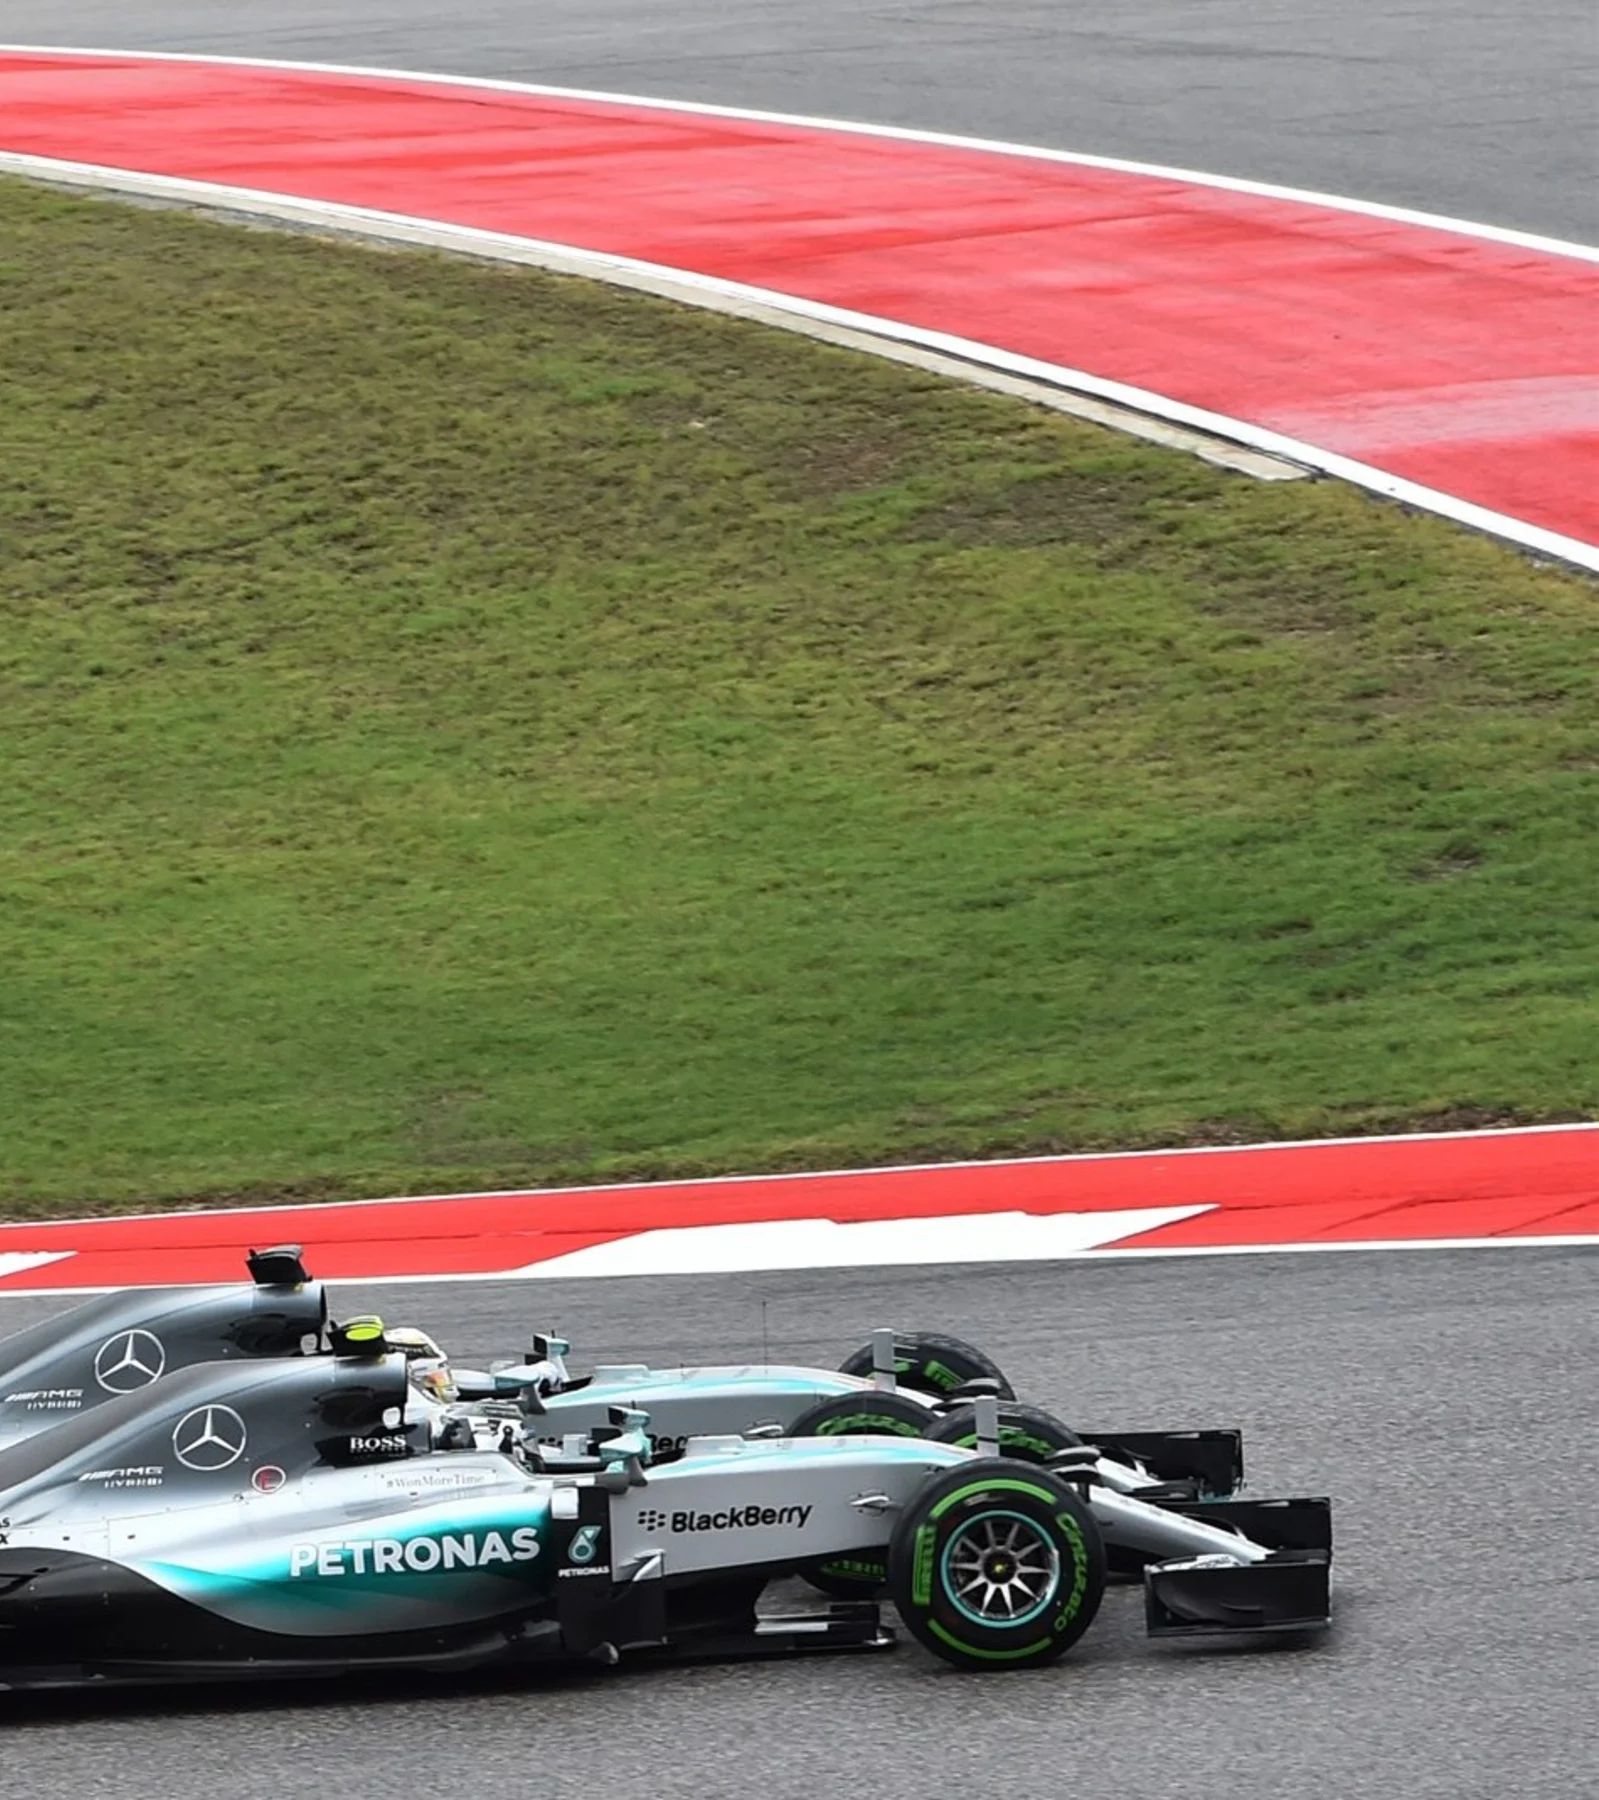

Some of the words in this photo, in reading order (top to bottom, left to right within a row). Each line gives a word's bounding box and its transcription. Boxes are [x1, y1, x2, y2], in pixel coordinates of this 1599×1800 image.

[32, 1388, 84, 1399] AMG
[349, 1434, 407, 1449] BOSS
[110, 1465, 164, 1476] AMG
[671, 1505, 813, 1533] BlackBerry
[290, 1527, 541, 1577] PETRONAS
[558, 1565, 610, 1578] PETRONAS
